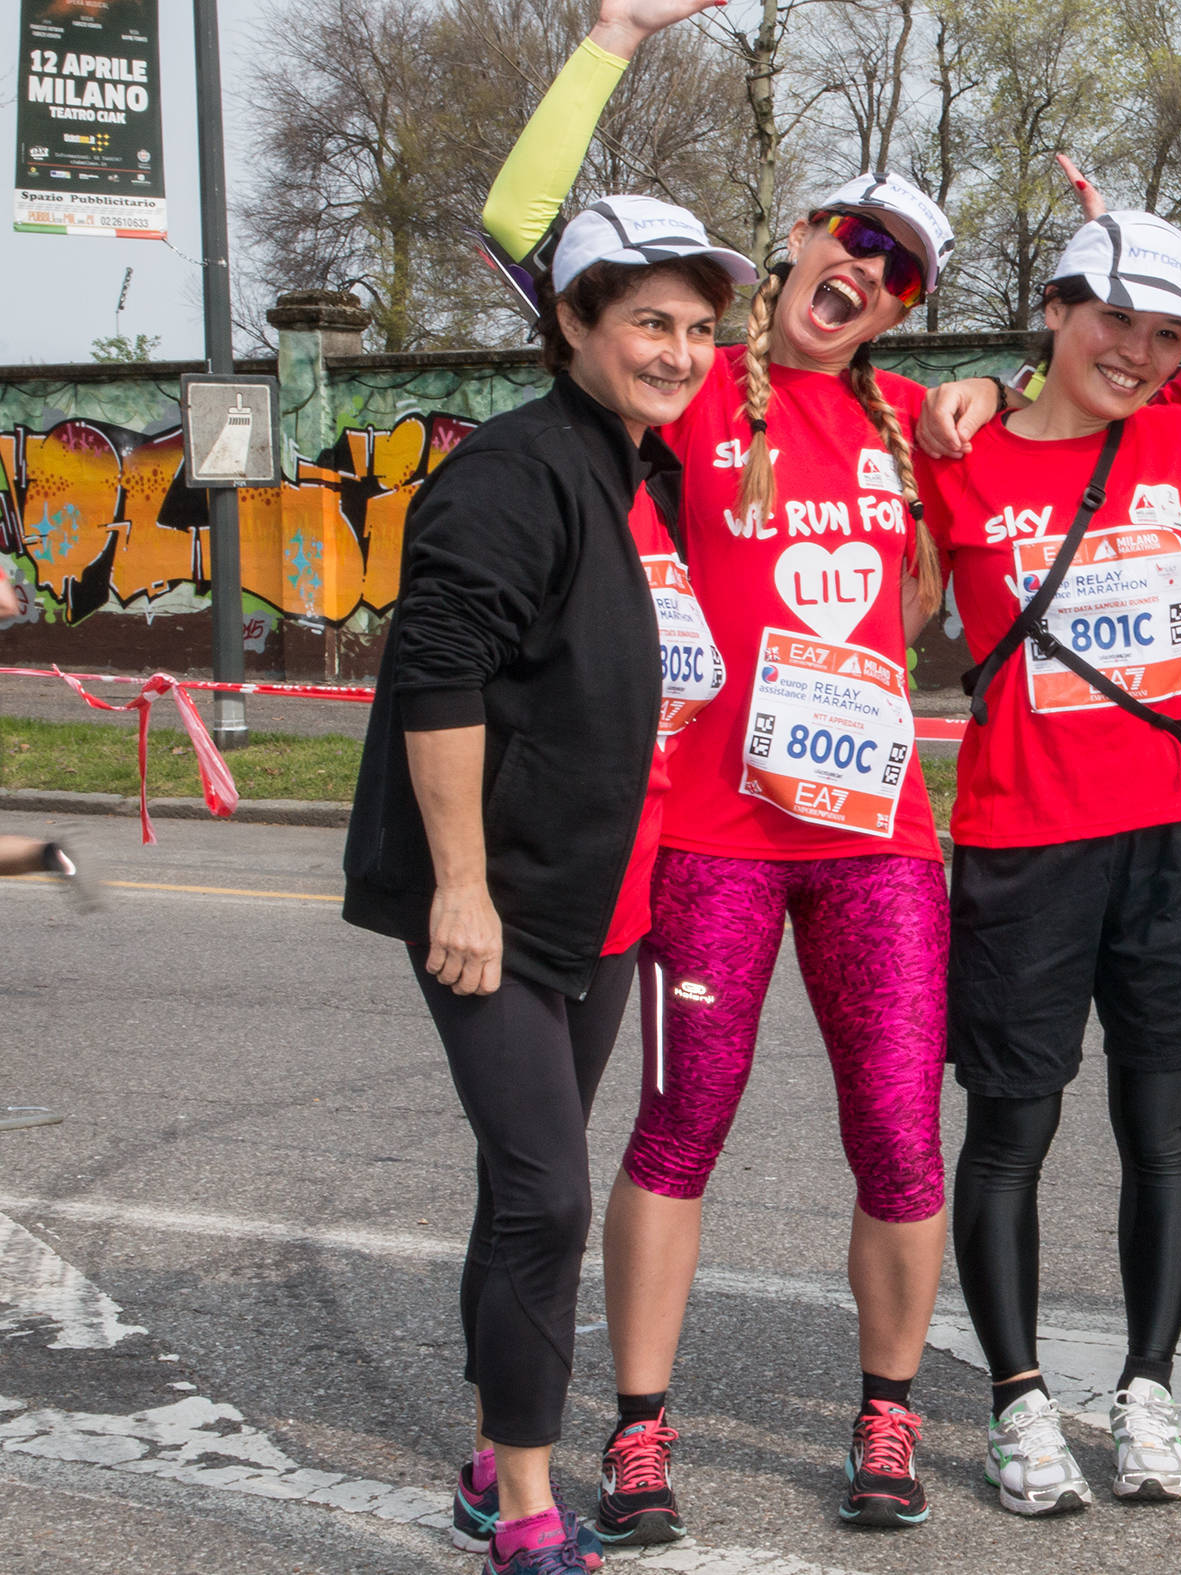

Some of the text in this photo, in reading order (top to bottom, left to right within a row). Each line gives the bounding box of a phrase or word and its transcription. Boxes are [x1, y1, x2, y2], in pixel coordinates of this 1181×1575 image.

[30, 50, 148, 83] 12 APRILE
[28, 75, 148, 112] MILANO
[49, 106, 127, 124] TEATRO CIAK
[21, 191, 156, 208] Spazio Pubblicitario
[1128, 247, 1160, 262] NTT
[785, 500, 851, 537] RUN
[857, 495, 905, 535] FOR
[985, 505, 1053, 541] sky
[1117, 533, 1160, 547] MILANO
[1118, 543, 1161, 555] MARATHON
[794, 568, 876, 606] LILT
[1075, 570, 1123, 586] RELAY
[1076, 579, 1148, 597] MARATHON
[1073, 605, 1092, 613] DATA
[1071, 612, 1155, 652] 801C
[789, 643, 831, 664] EA7
[759, 685, 807, 700] assistance
[780, 679, 808, 691] europ
[814, 681, 862, 701] RELAY
[812, 693, 879, 716] MARATHON
[787, 724, 878, 774] 800C
[795, 782, 849, 813] EA7
